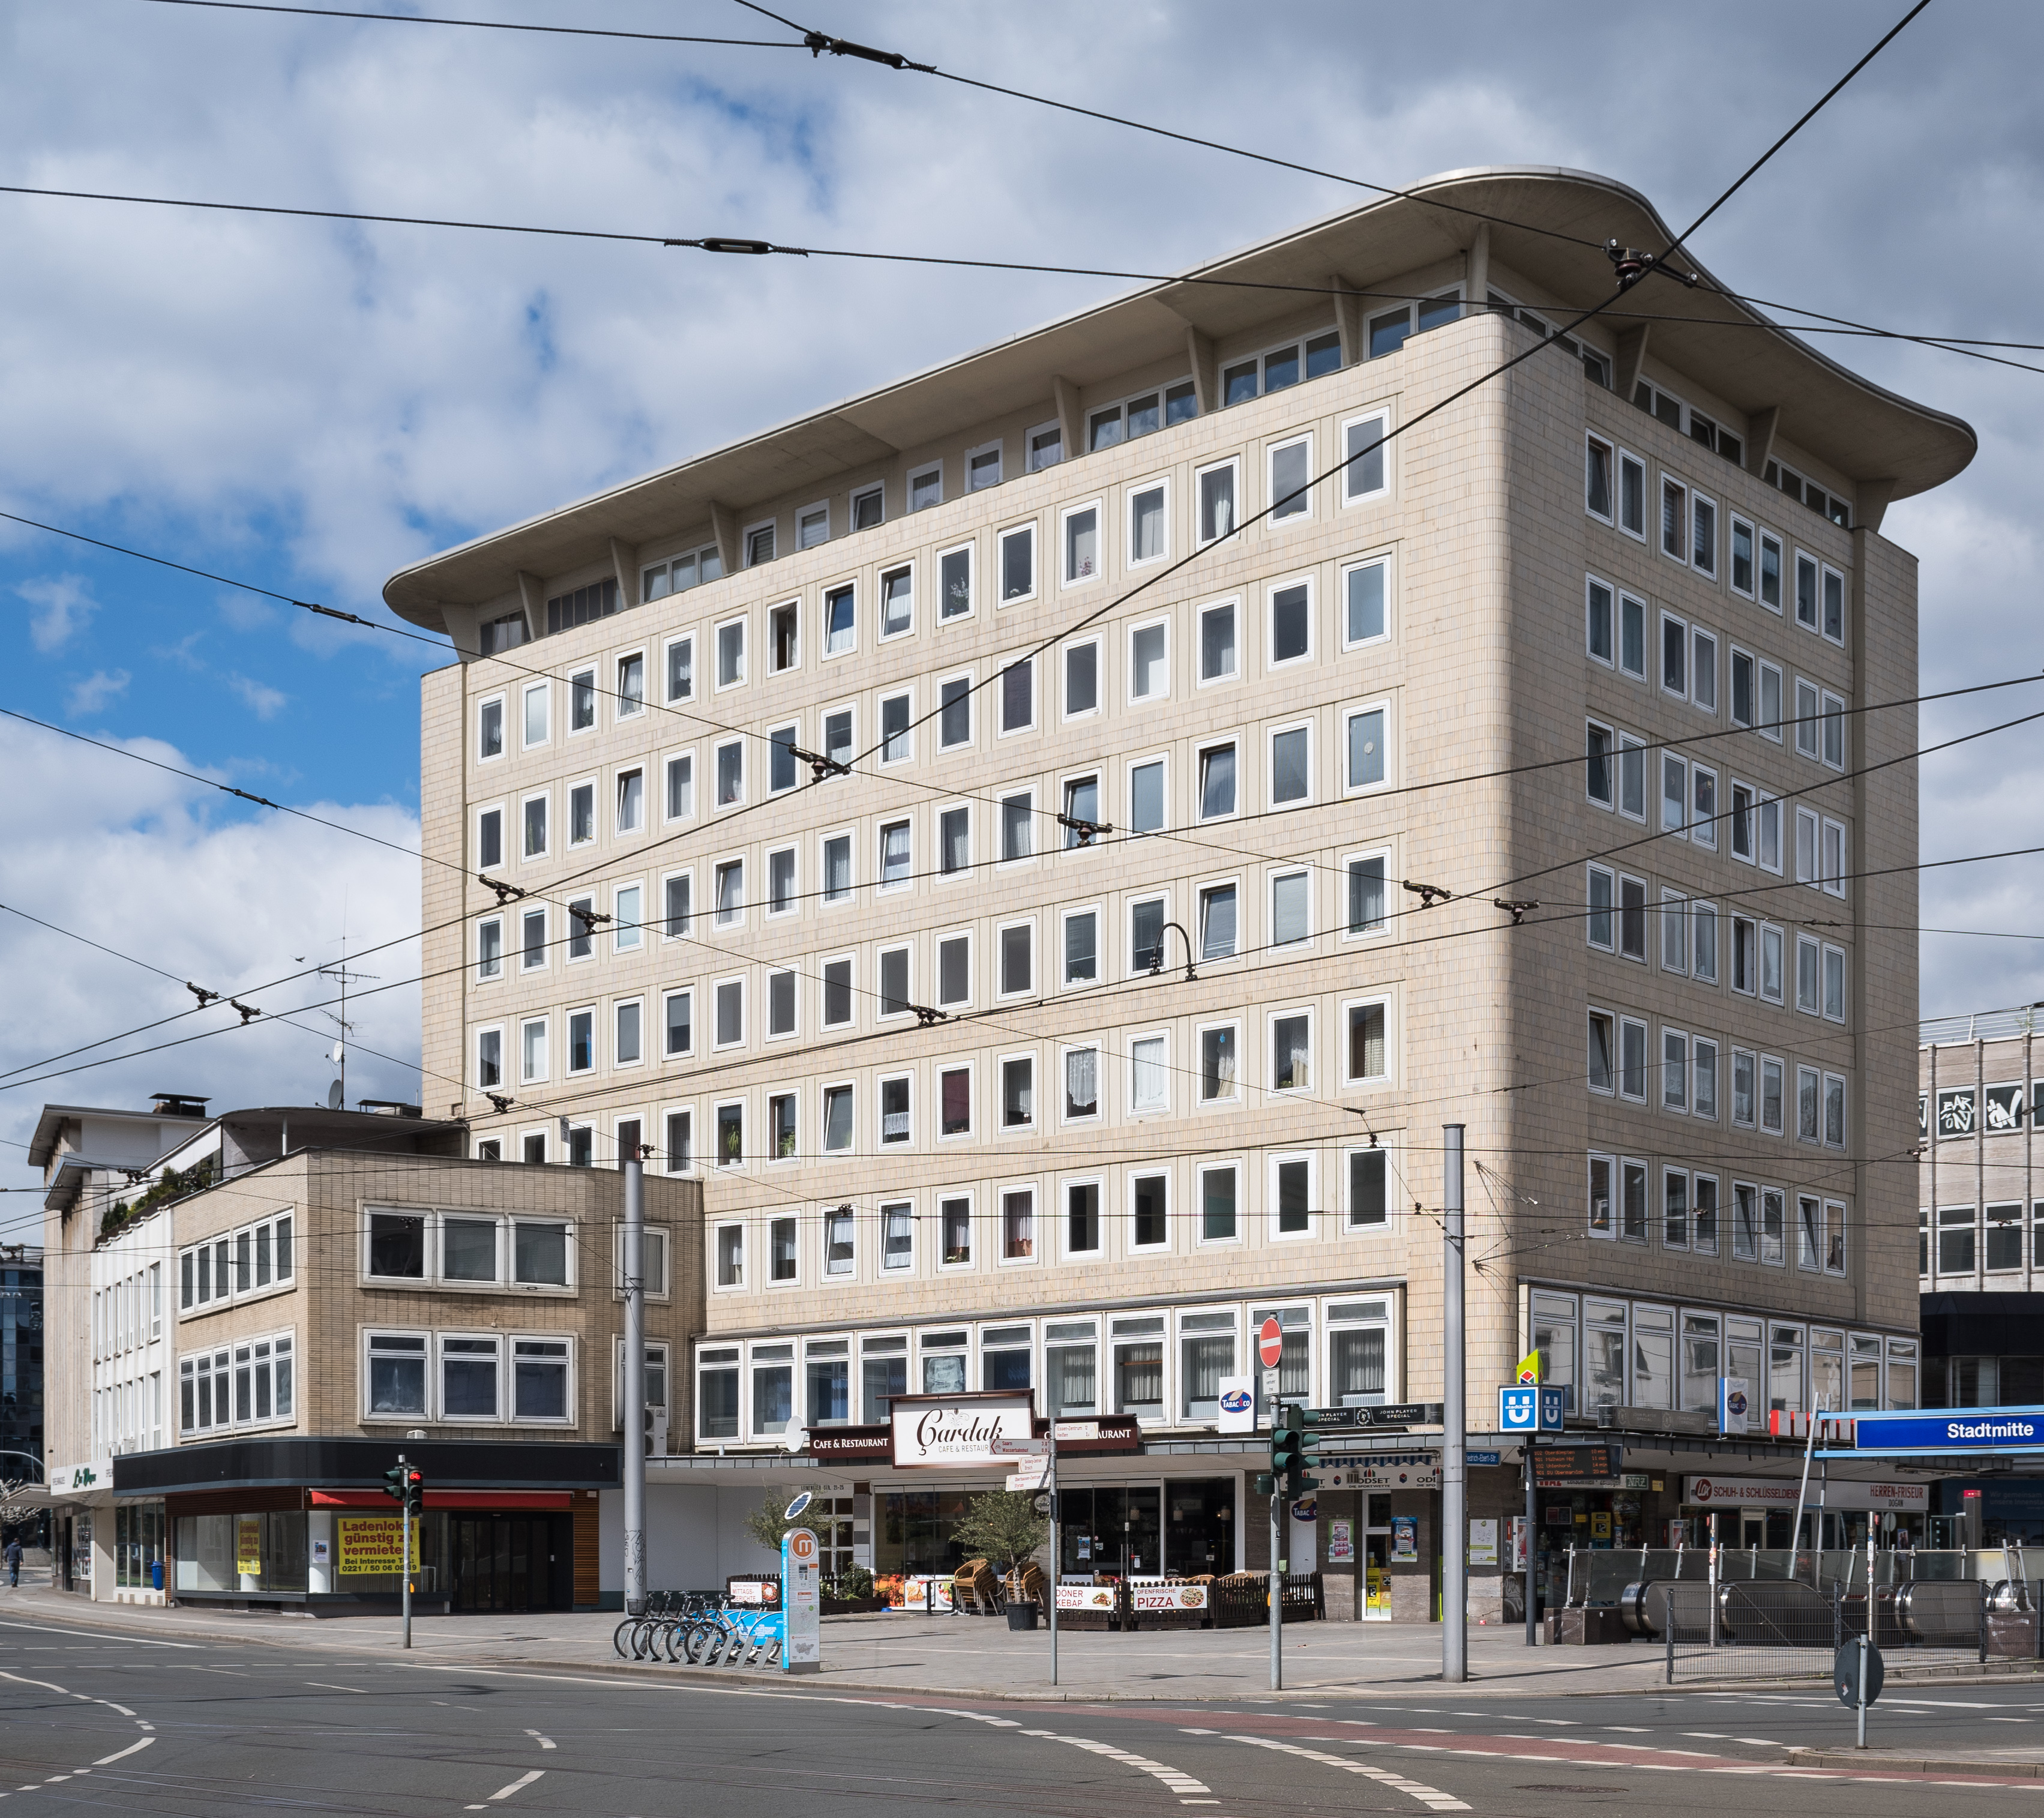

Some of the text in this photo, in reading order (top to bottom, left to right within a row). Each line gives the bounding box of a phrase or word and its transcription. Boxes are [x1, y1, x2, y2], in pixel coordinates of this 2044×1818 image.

[1947, 1422, 2034, 1439] Stadtmitte
[833, 1439, 840, 1448] &
[1627, 1477, 1647, 1487] NRZ
[1714, 1486, 1801, 1499] SCHUH- & SCHLÜSSELDIENS
[1870, 1485, 1923, 1499] HERREN-FRISEUR
[343, 1520, 414, 1531] Ladenlokl
[344, 1532, 394, 1546] günstig
[343, 1545, 414, 1555] vermiete.
[1056, 1588, 1083, 1598] DÖNER
[1056, 1599, 1083, 1607] KEBAP
[1137, 1597, 1174, 1608] PIZZA
